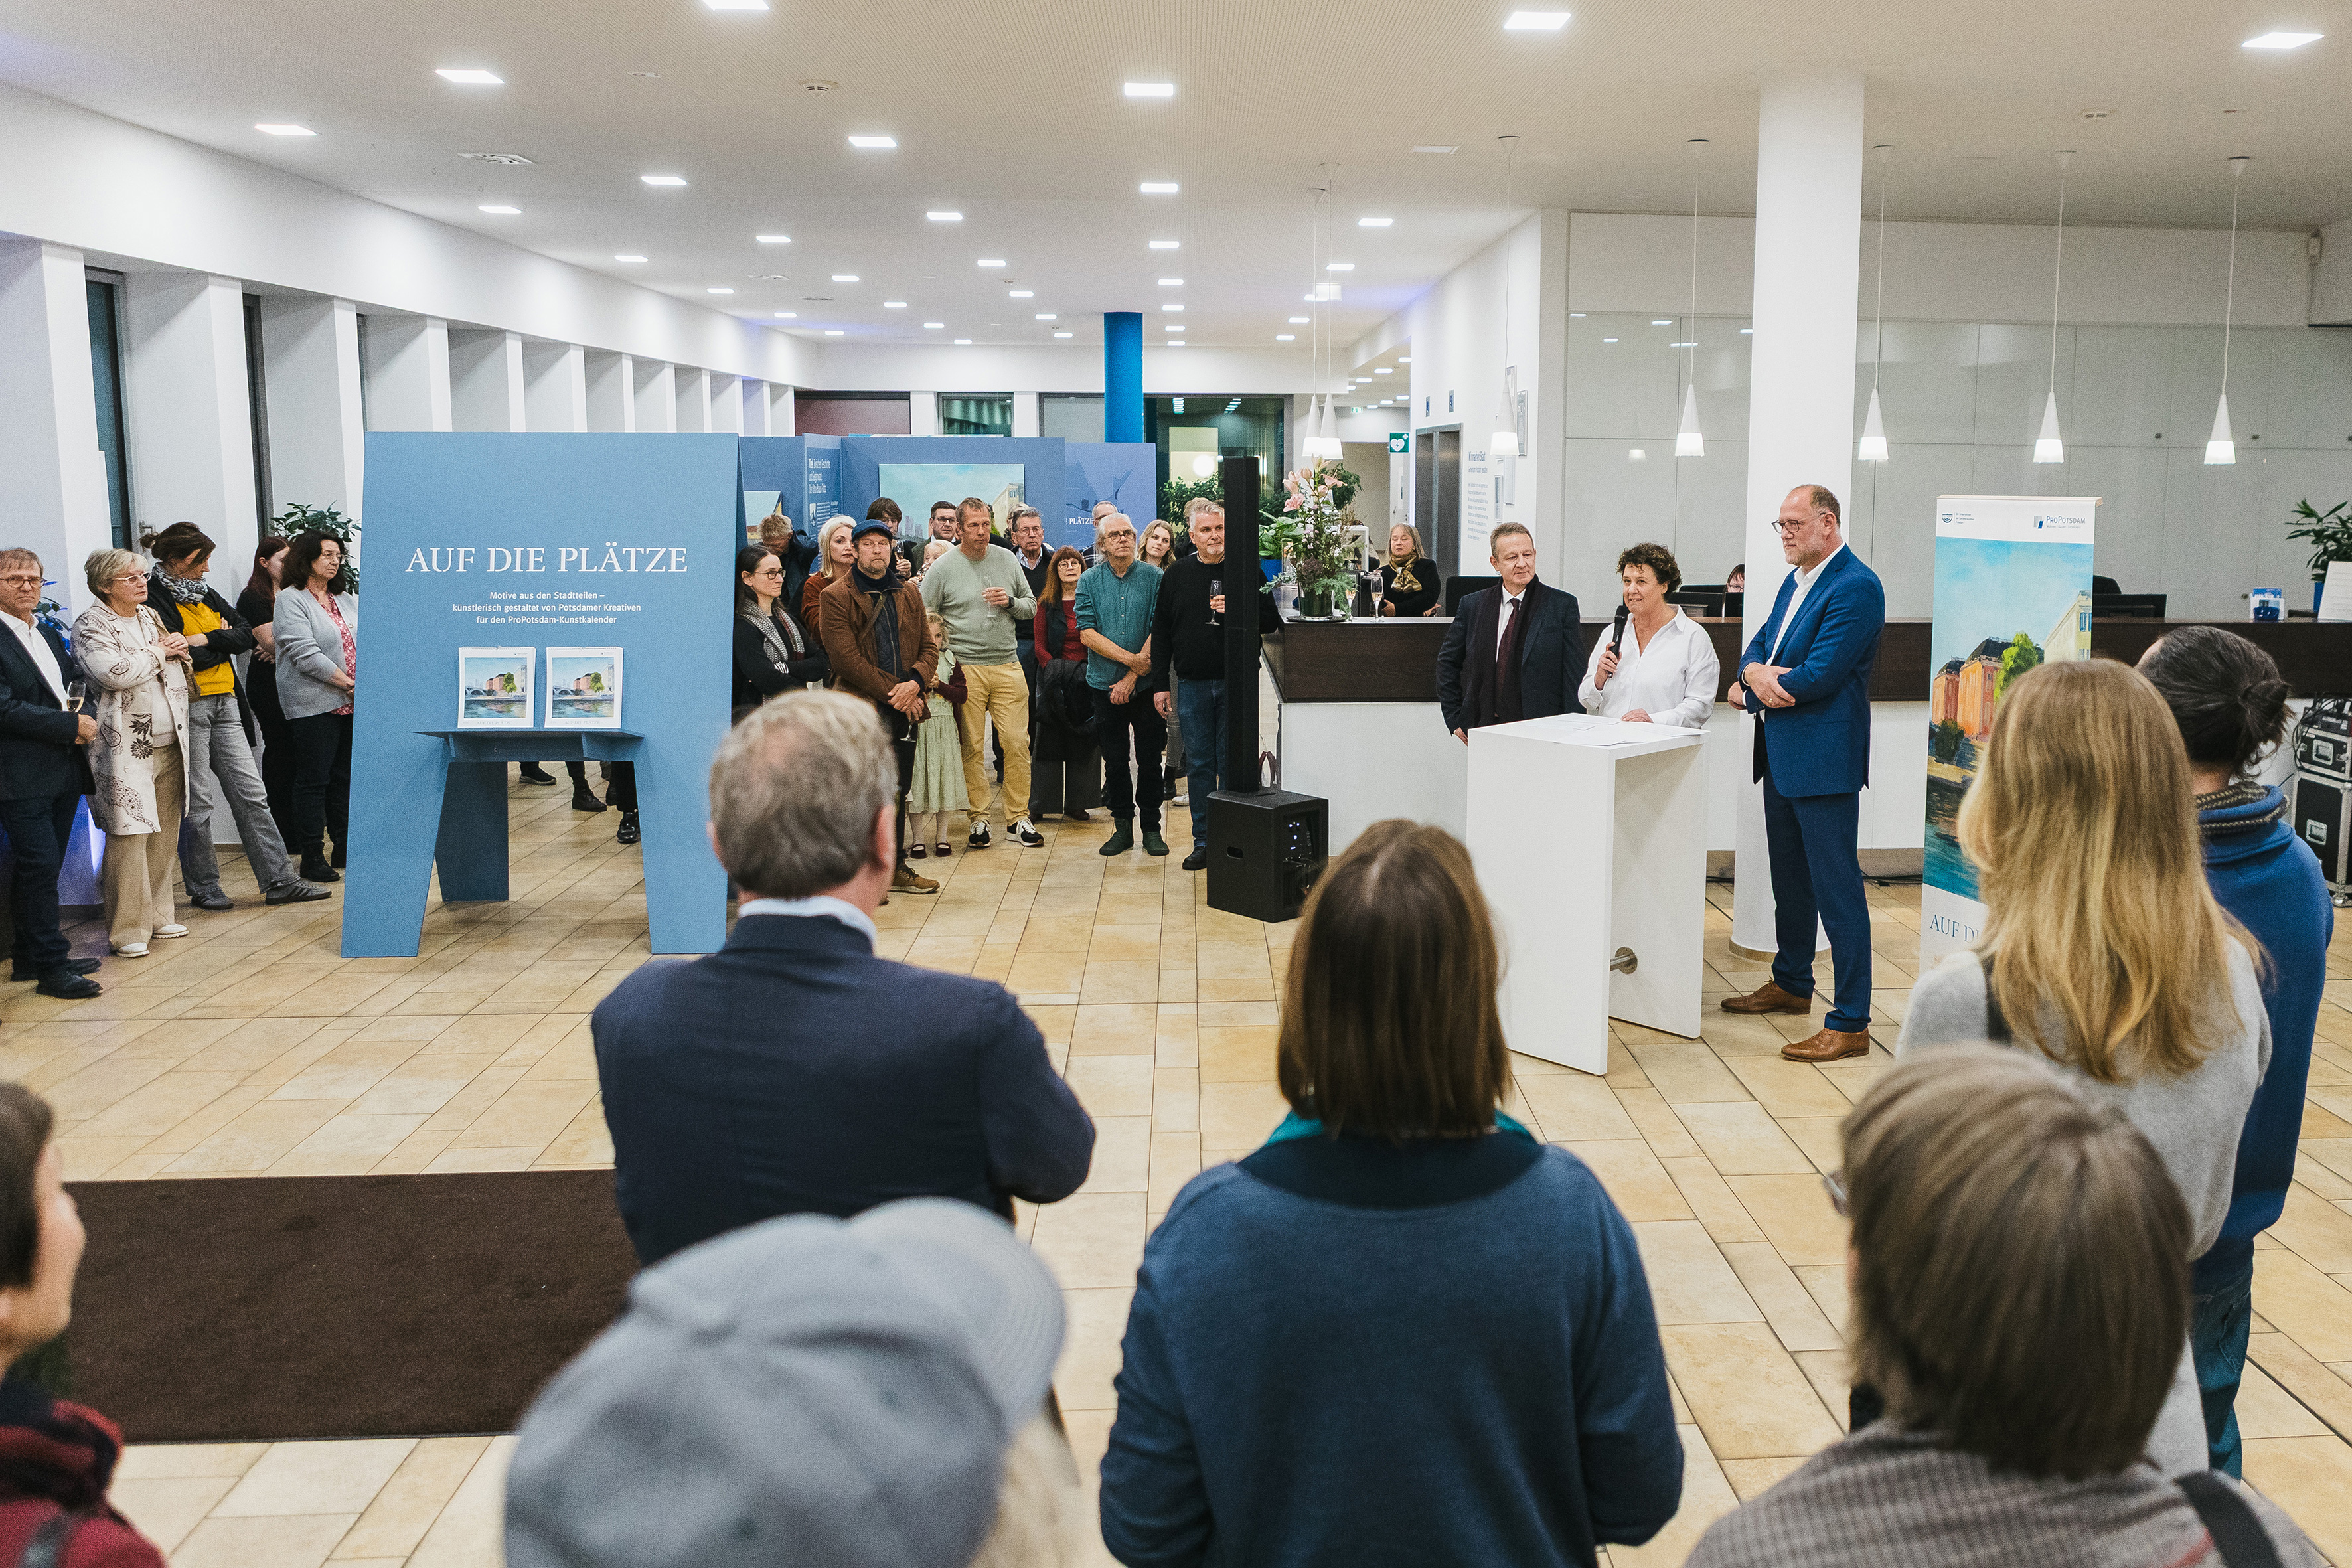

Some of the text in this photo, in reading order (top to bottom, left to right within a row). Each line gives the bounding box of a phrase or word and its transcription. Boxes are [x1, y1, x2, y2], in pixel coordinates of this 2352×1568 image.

[404, 541, 688, 572] AUF DIE PLÄTZE
[504, 603, 540, 613] gestaltet
[477, 615, 489, 624] für
[508, 615, 617, 624] ProPotsdam-Kunstkalender
[1929, 913, 1981, 943] AUF DI
